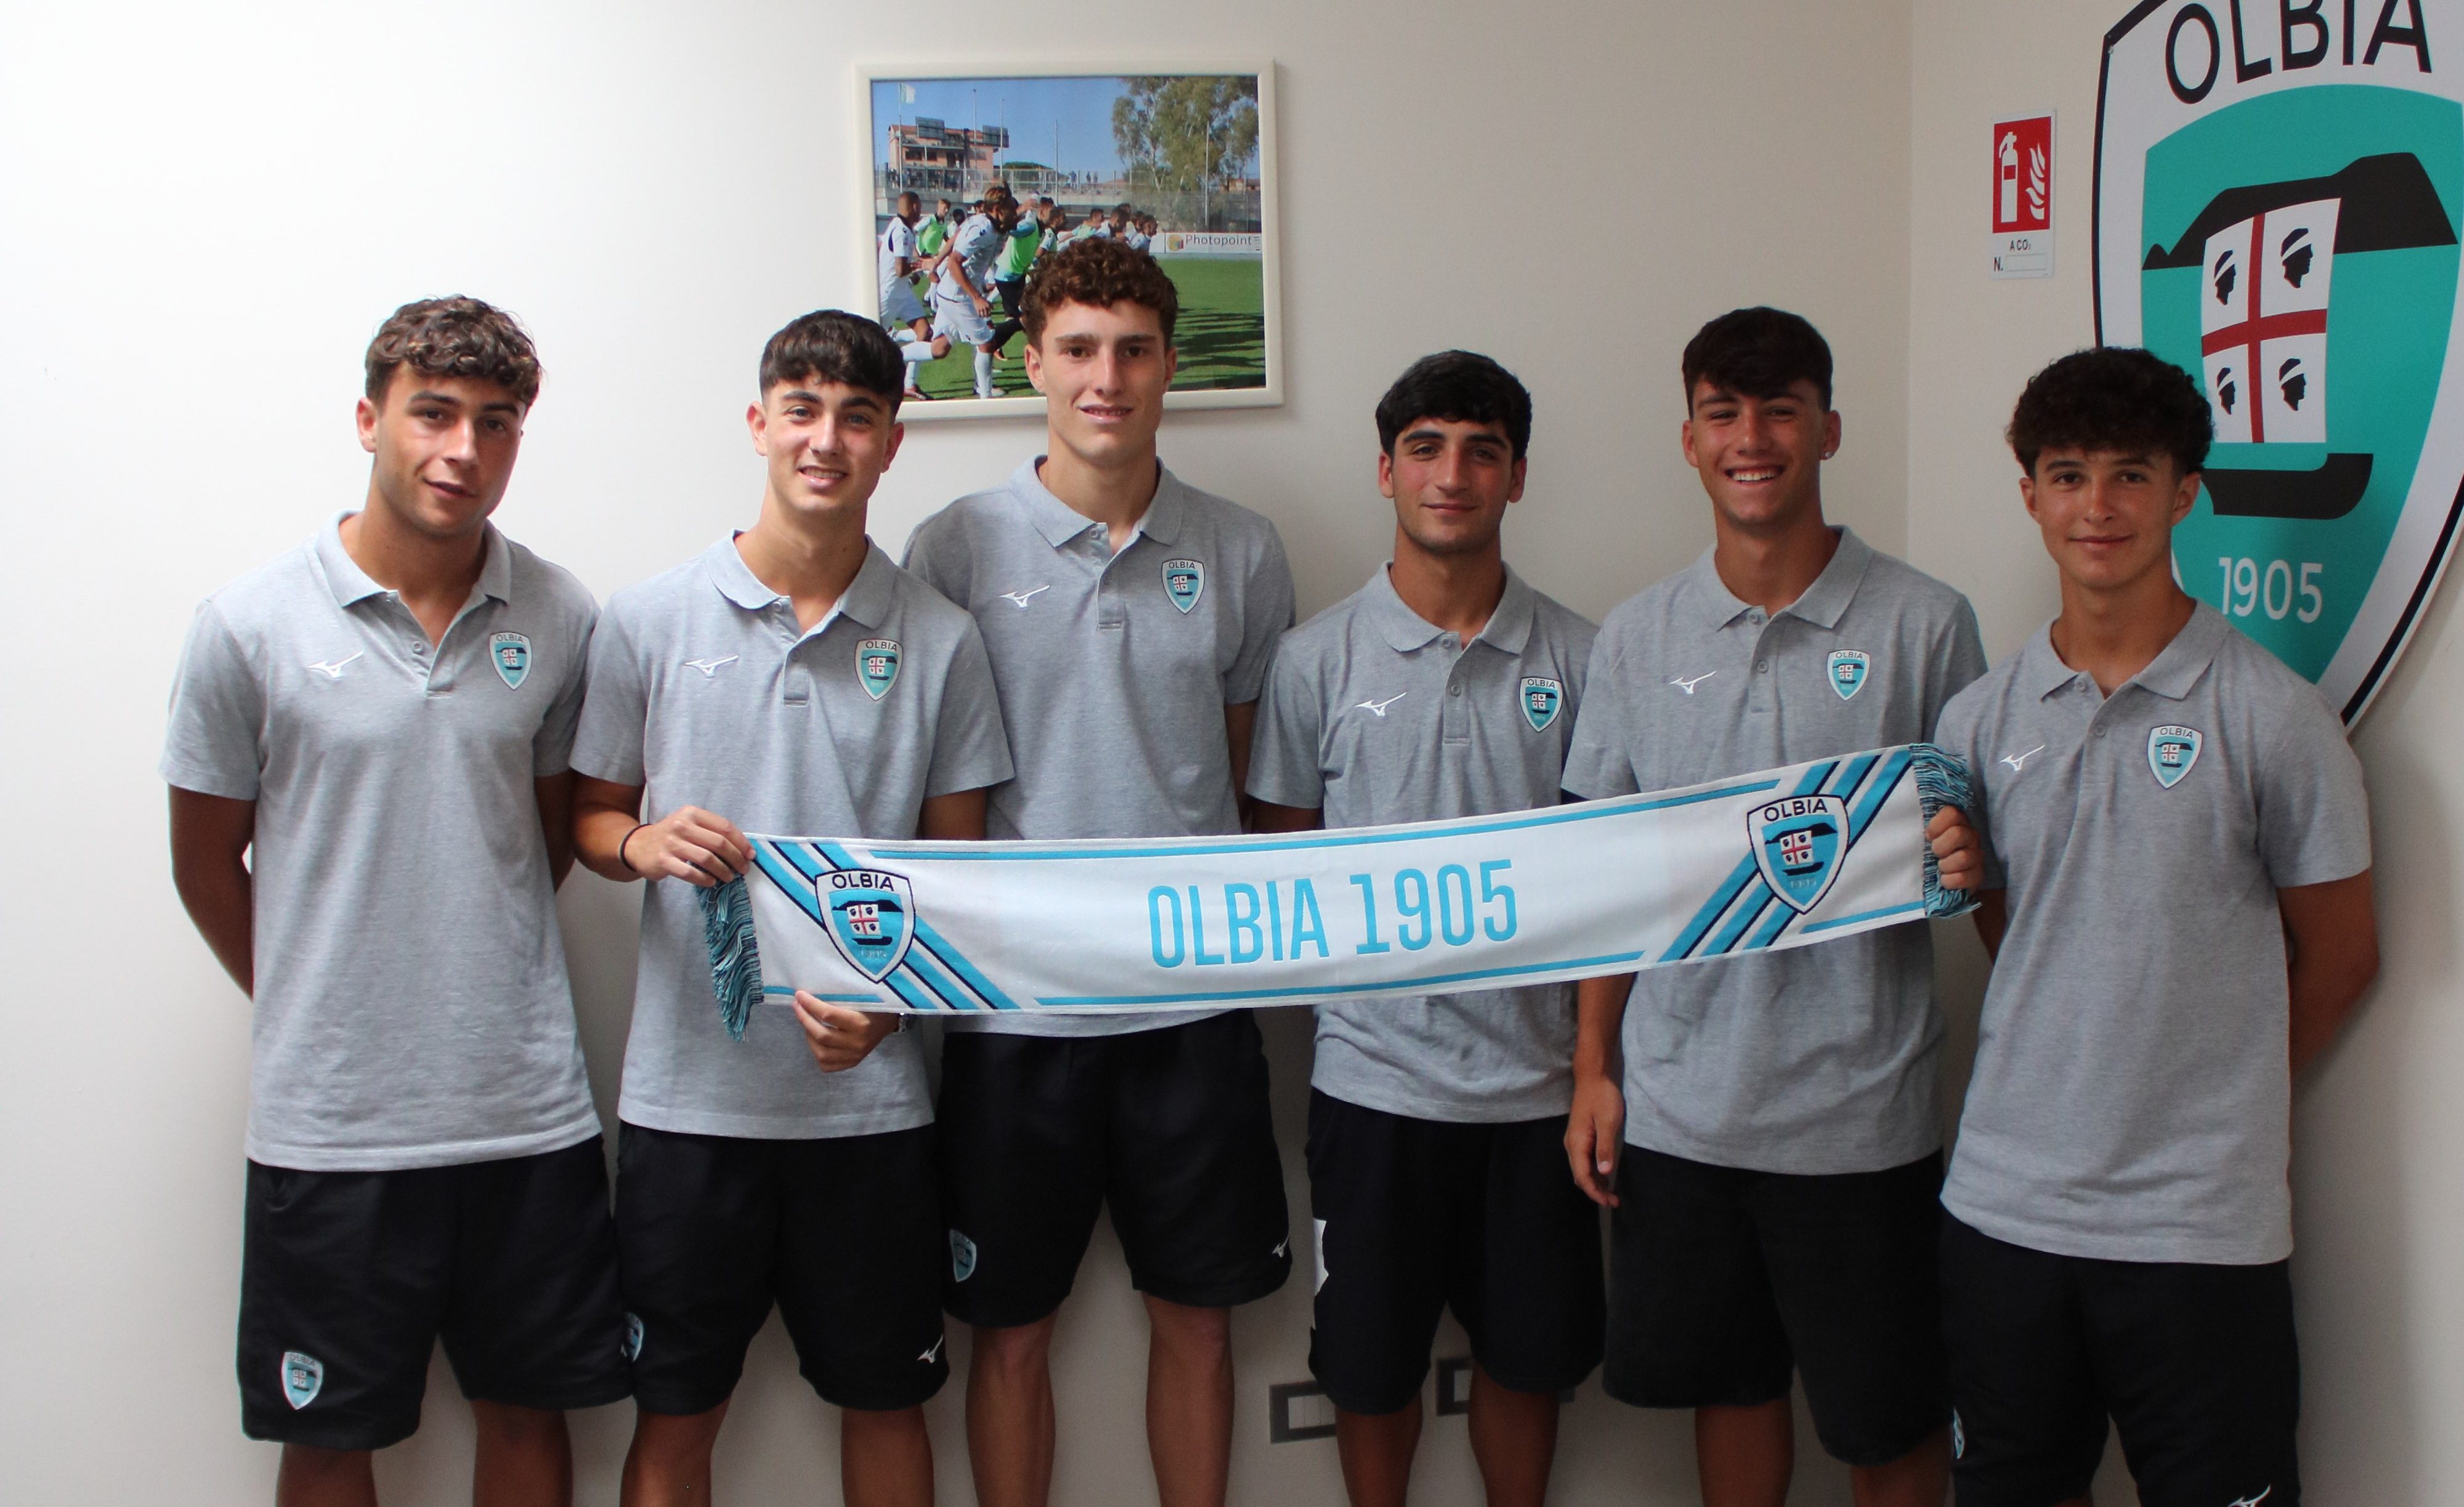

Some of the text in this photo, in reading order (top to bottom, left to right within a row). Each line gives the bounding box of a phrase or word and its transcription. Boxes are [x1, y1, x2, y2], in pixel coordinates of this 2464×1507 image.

[2165, 0, 2432, 104] OLBIA
[1186, 234, 1252, 246] Photopoint
[2009, 240, 2015, 251] A
[1993, 256, 2004, 272] N.
[1169, 561, 1196, 569] OLBIA
[2218, 557, 2323, 623] 1905
[496, 634, 524, 643] OLBIA
[865, 641, 898, 652] OLBIA
[1836, 652, 1863, 660] OLBIA
[1528, 679, 1556, 689] OLBIA
[2160, 727, 2193, 738] OLBIA
[1764, 798, 1828, 822] OLBIA
[832, 873, 894, 892] OLBIA
[1147, 859, 1518, 969] OLBIA 1905
